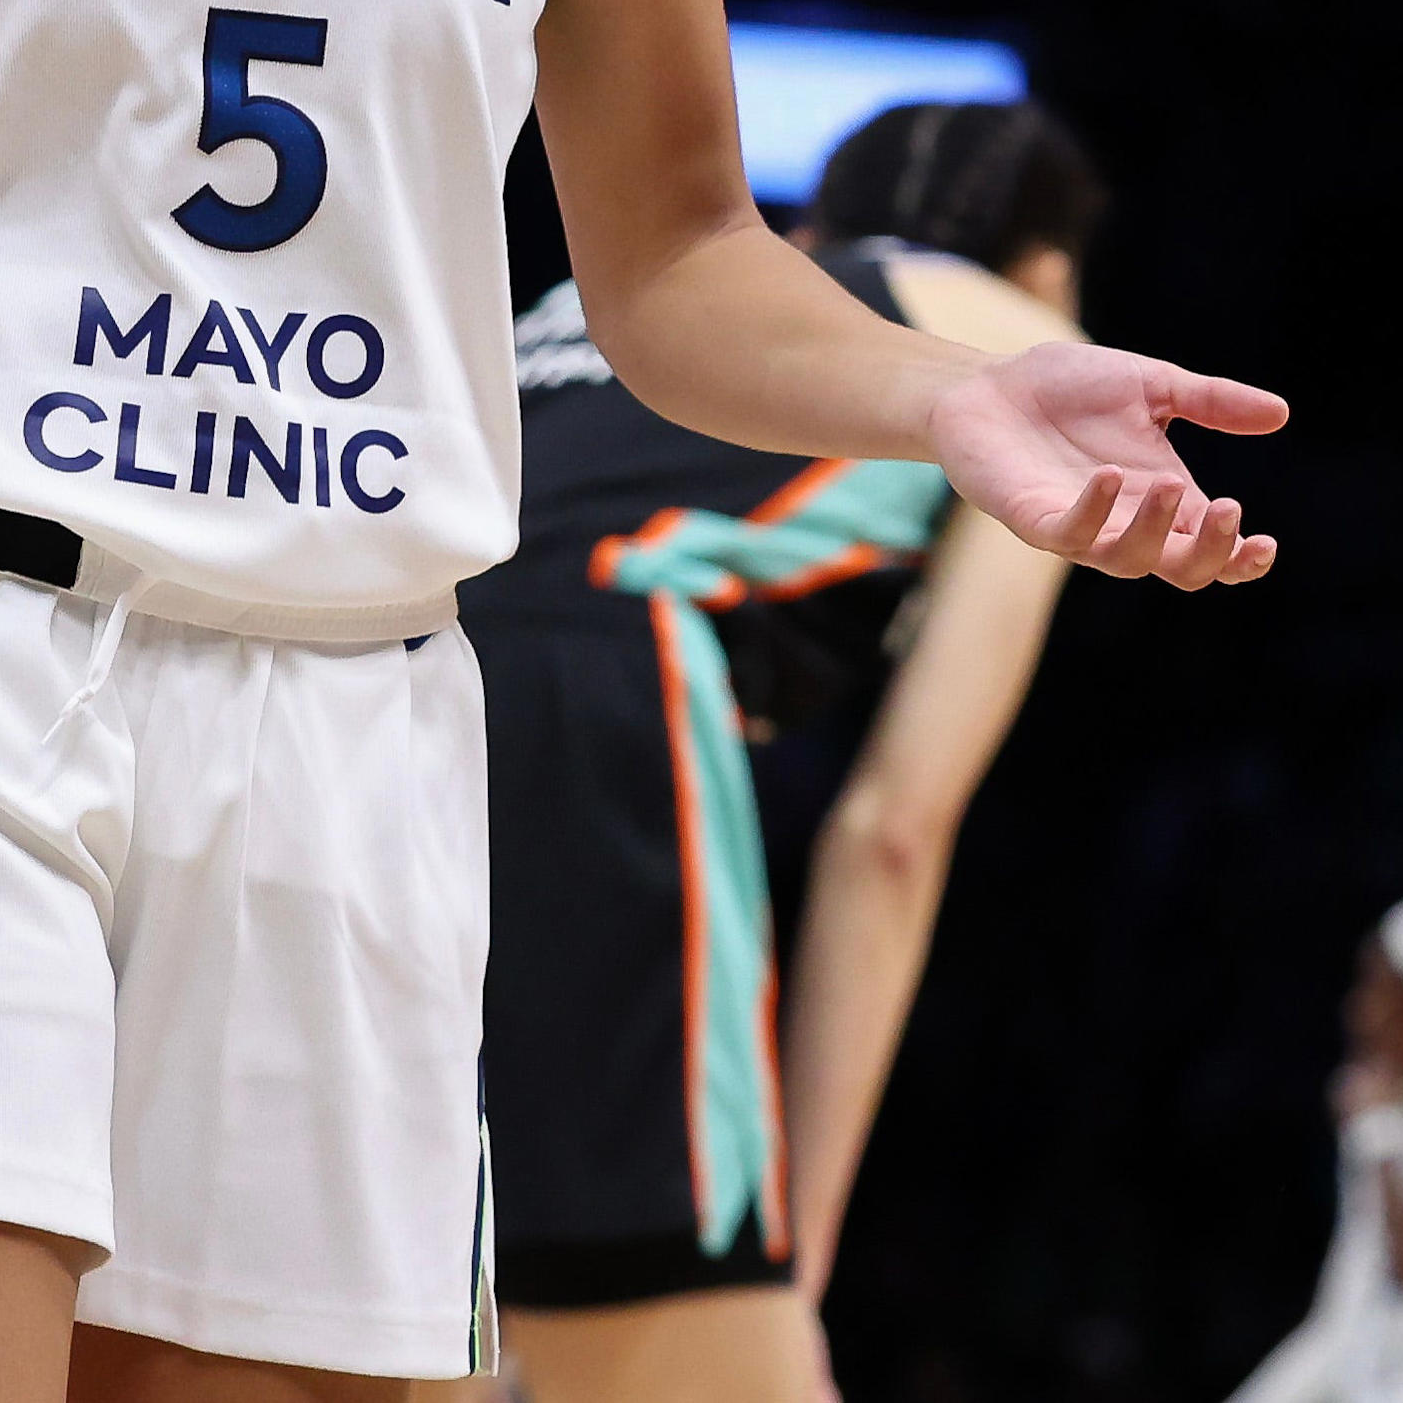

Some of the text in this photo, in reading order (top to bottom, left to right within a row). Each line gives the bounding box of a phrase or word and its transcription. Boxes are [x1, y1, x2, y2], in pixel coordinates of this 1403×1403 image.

[169, 7, 328, 252] 5
[73, 286, 385, 399] MAYO
[23, 391, 409, 513] CLINIC
